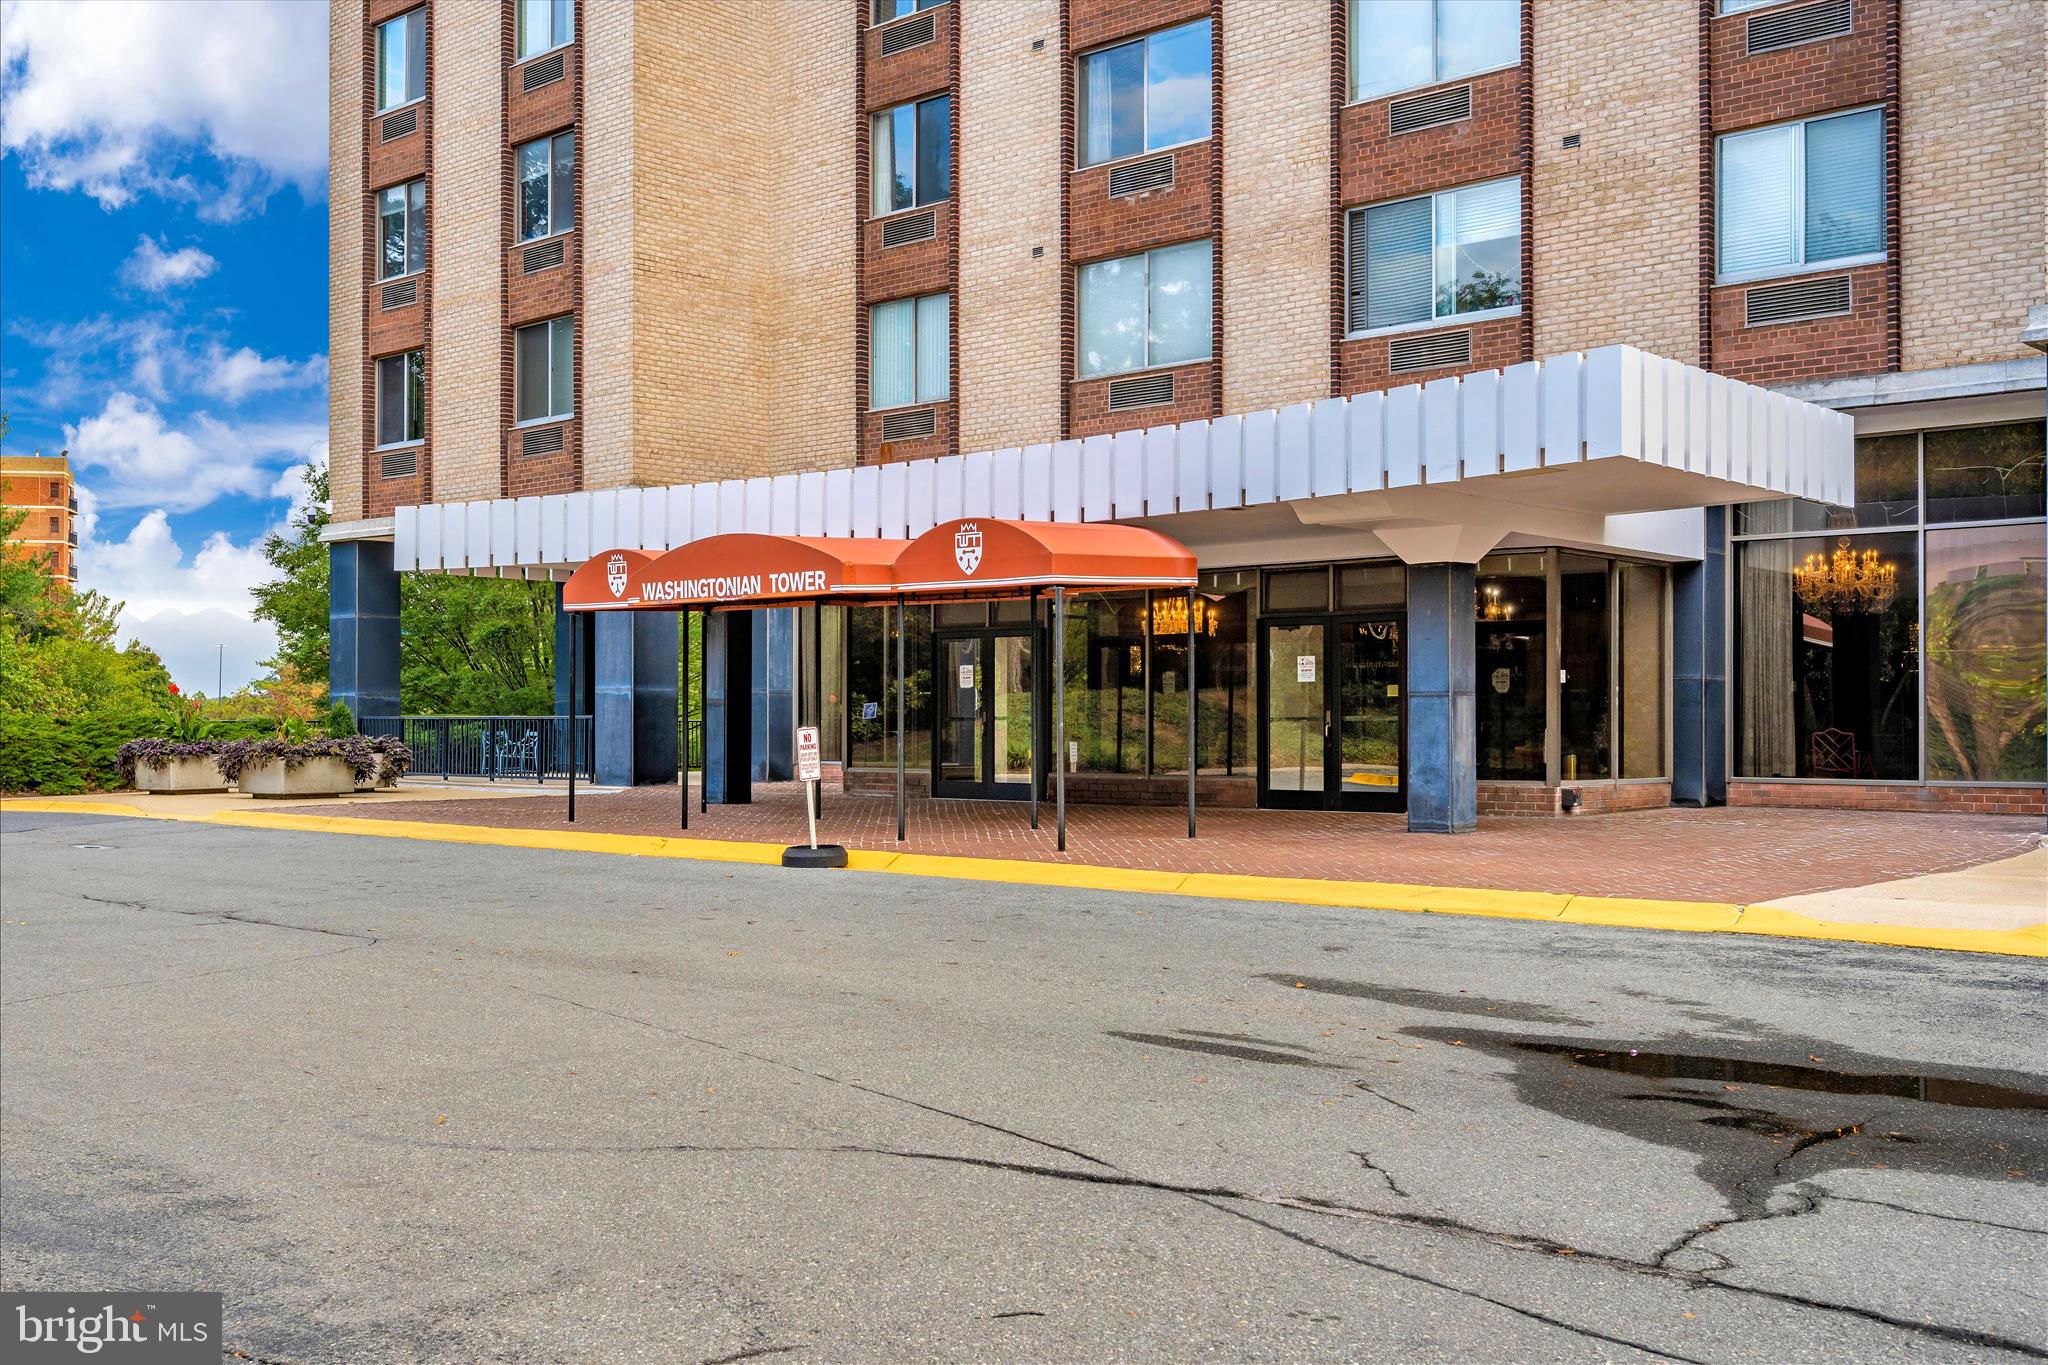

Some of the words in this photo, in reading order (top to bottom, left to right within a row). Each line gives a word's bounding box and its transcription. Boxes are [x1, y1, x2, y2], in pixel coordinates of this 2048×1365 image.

[642, 575, 761, 601] WASHINGTONIAN
[769, 570, 826, 593] TOWER
[803, 733, 811, 742] NO
